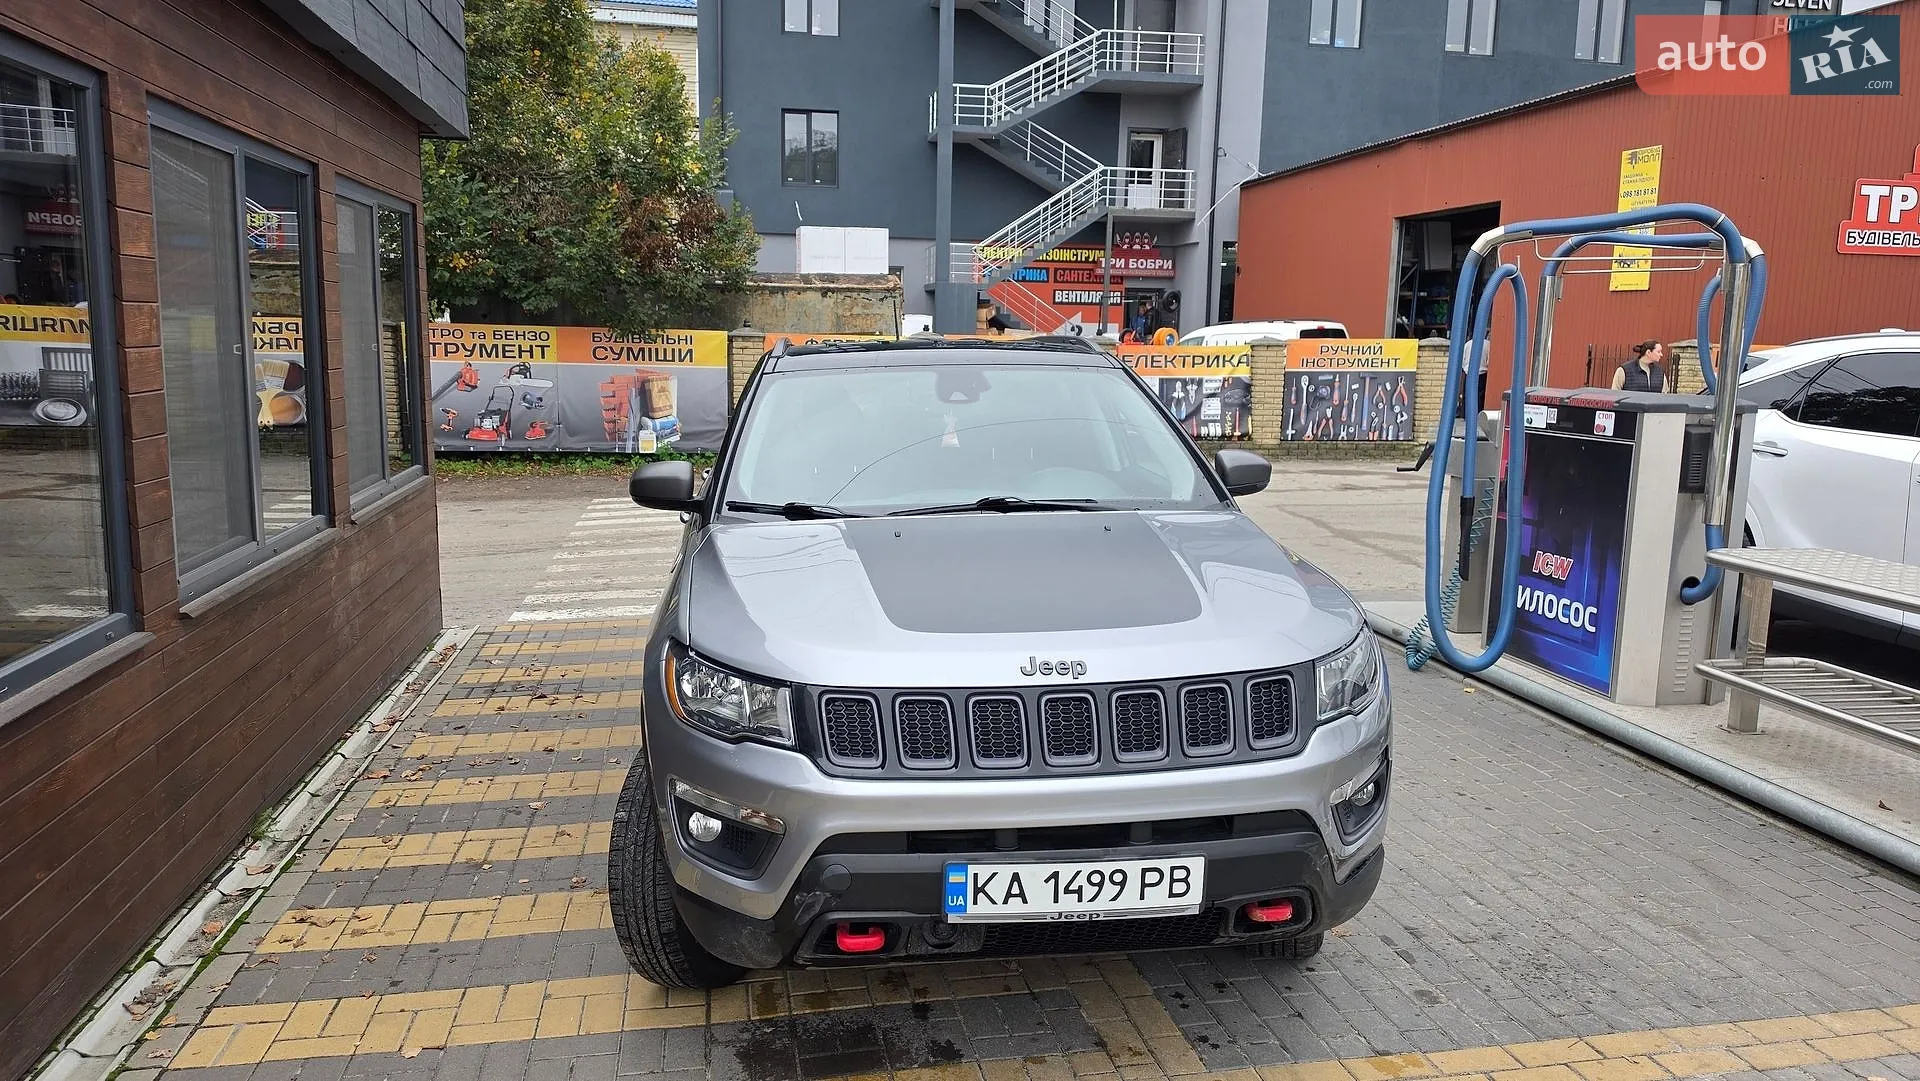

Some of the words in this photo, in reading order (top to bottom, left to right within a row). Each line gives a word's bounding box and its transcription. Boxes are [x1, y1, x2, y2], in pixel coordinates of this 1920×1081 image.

[1860, 185, 1920, 223] ТР
[1129, 259, 1173, 270] БОБРИ
[1055, 290, 1121, 305] ВЕНТИЛЯІЯ
[430, 328, 464, 339] ТРО
[470, 331, 486, 340] та
[493, 330, 550, 341] БЕНЗО
[430, 342, 550, 359] ТРУМЕНТ
[592, 346, 693, 362] СУМІШИ
[1320, 342, 1383, 355] РУЧНИЙ
[1122, 354, 1250, 368] ЕЛЕКТРИКА
[1301, 357, 1400, 368] ІНСТРУМЕНТ
[1532, 550, 1573, 580] ICW
[1516, 585, 1597, 632] ИЛОСОС
[1020, 656, 1087, 679] Jeep
[972, 872, 1028, 906] KA
[1043, 868, 1128, 904] 1499
[1139, 865, 1191, 901] PB
[948, 896, 965, 907] UA
[1050, 911, 1100, 921] Jeep
